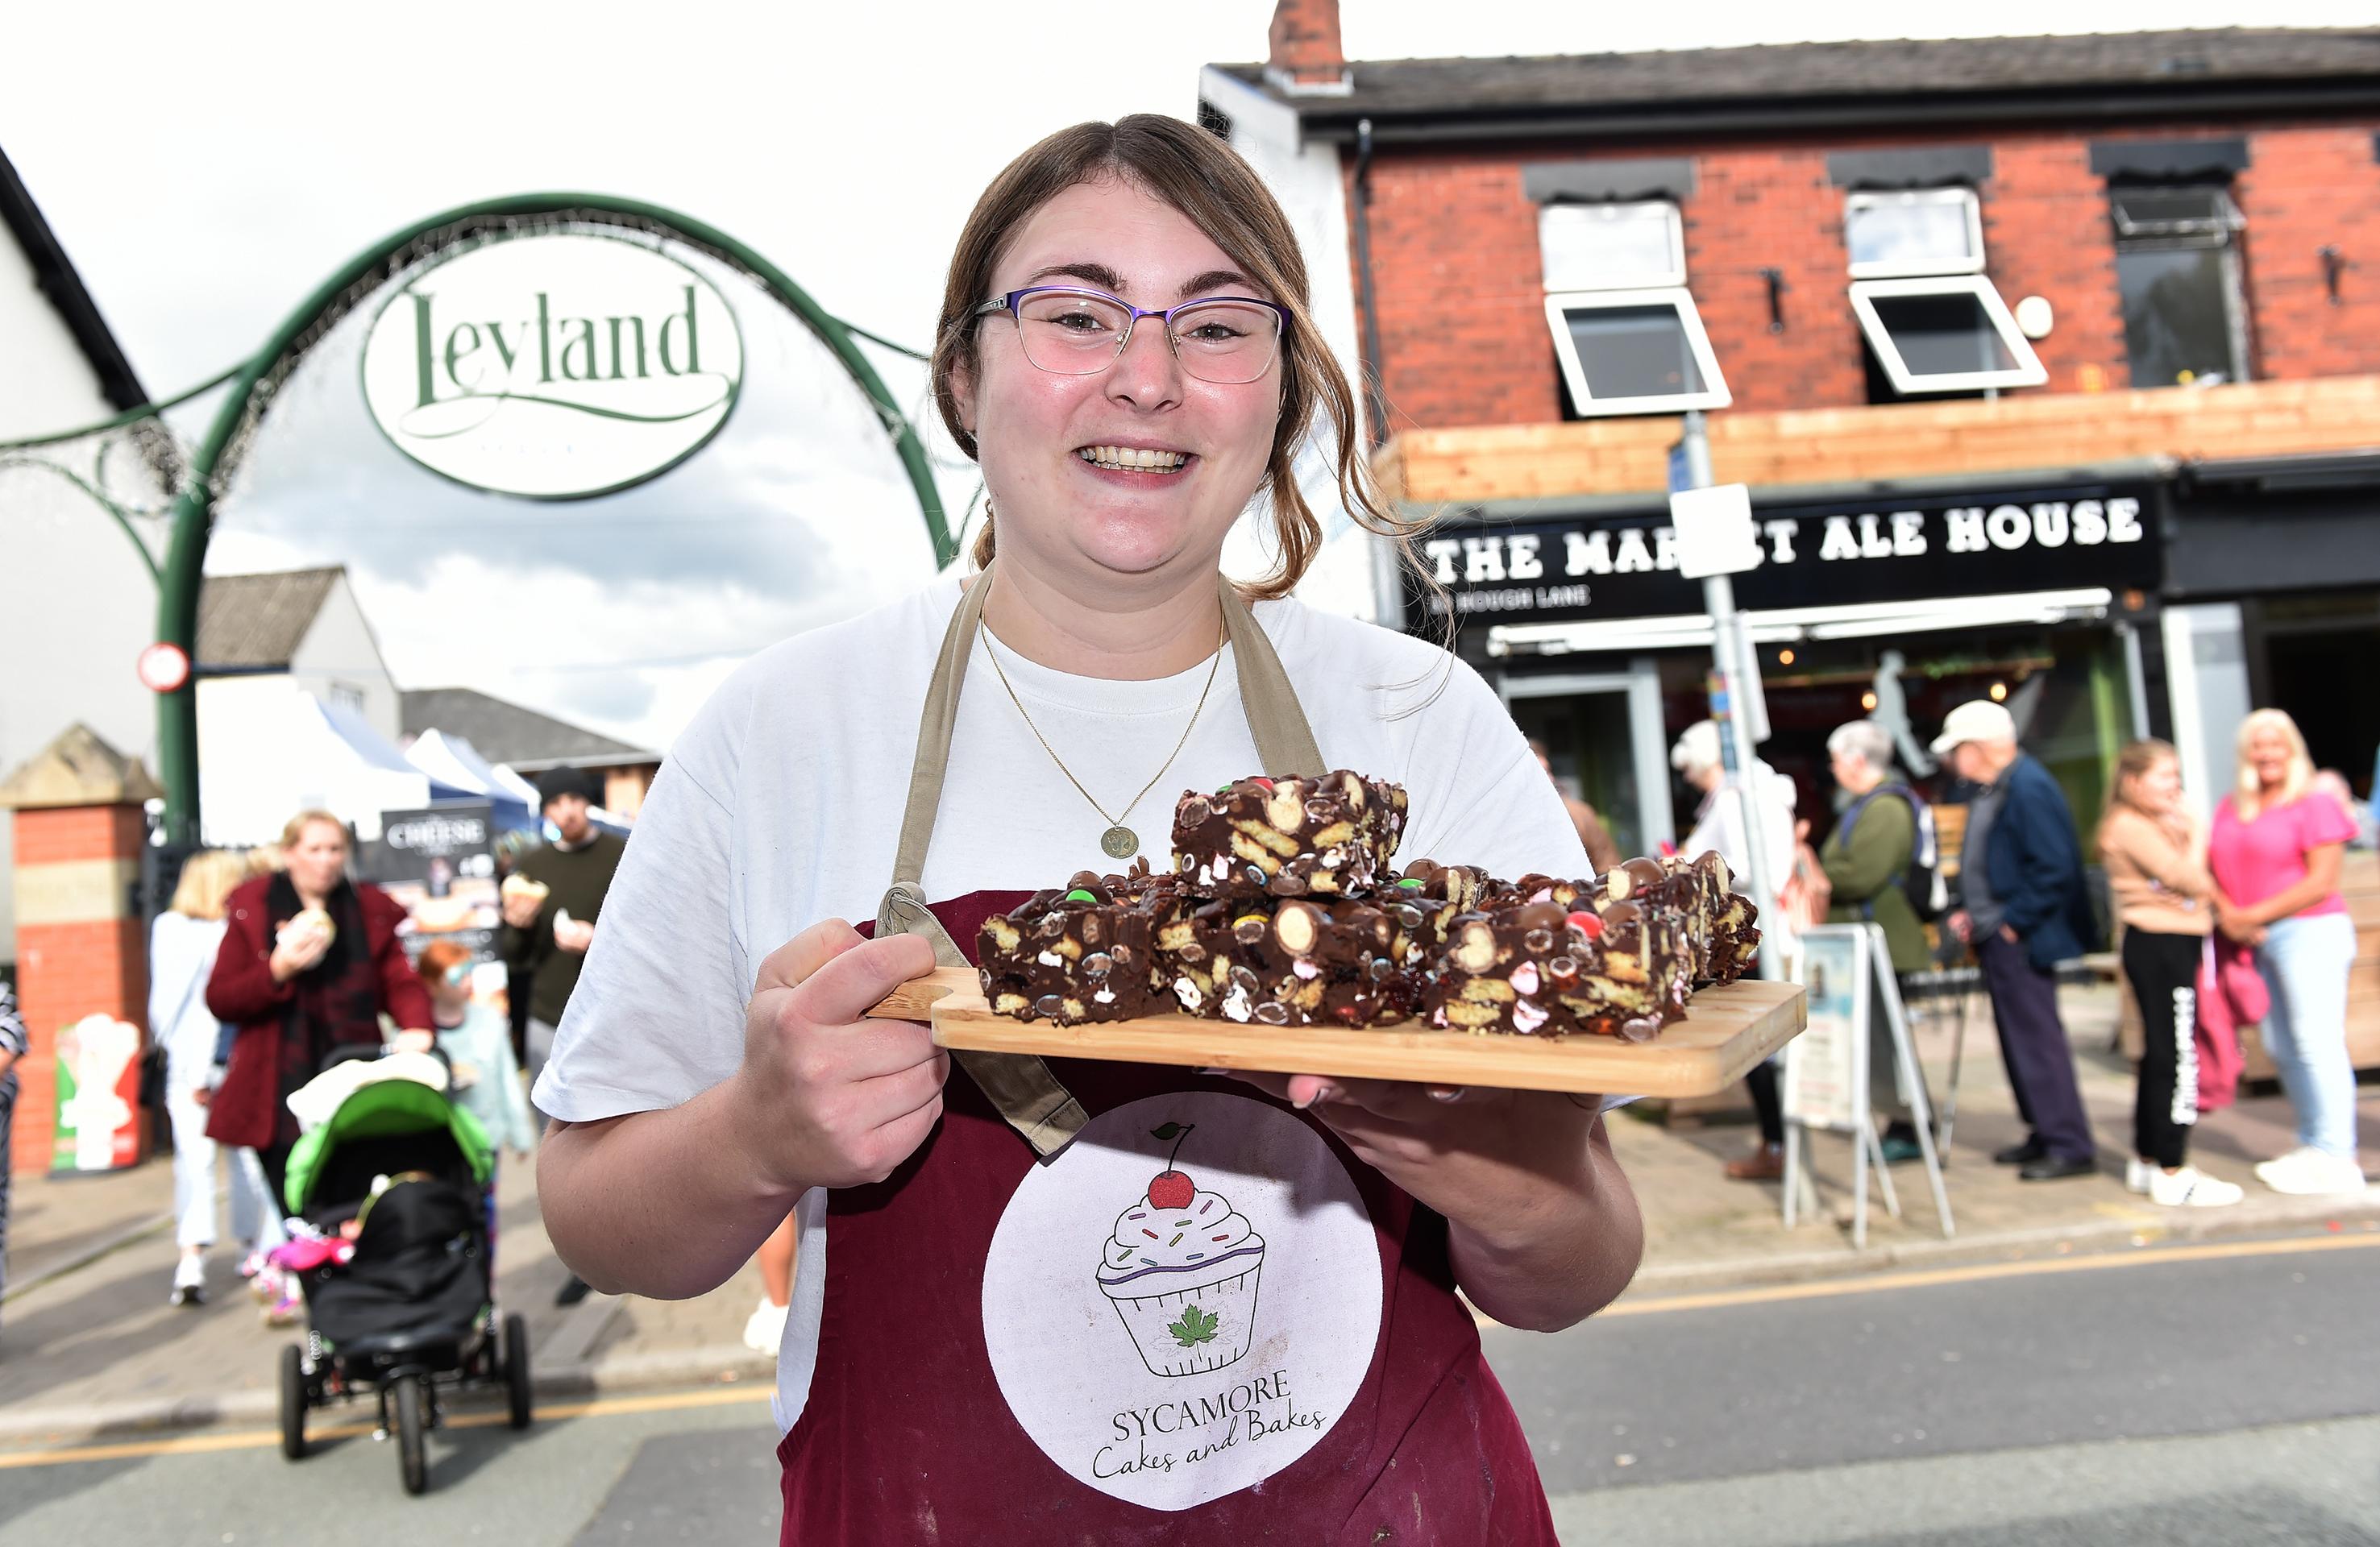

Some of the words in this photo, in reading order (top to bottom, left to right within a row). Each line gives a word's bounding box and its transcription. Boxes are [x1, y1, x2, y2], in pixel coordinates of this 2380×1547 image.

[403, 284, 703, 410] Leyland
[1425, 533, 1543, 585] THE
[1563, 518, 1799, 576] MART
[1820, 511, 1927, 561] ALE
[1944, 497, 2143, 554] HOUSE
[1456, 587, 1533, 613] HOUGH
[1535, 583, 1591, 609] LANE
[1092, 1439, 1178, 1479] Cakes
[1186, 1415, 1239, 1464] and
[1244, 1398, 1327, 1441] Bakes
[1112, 1369, 1291, 1441] SYCAMORE
